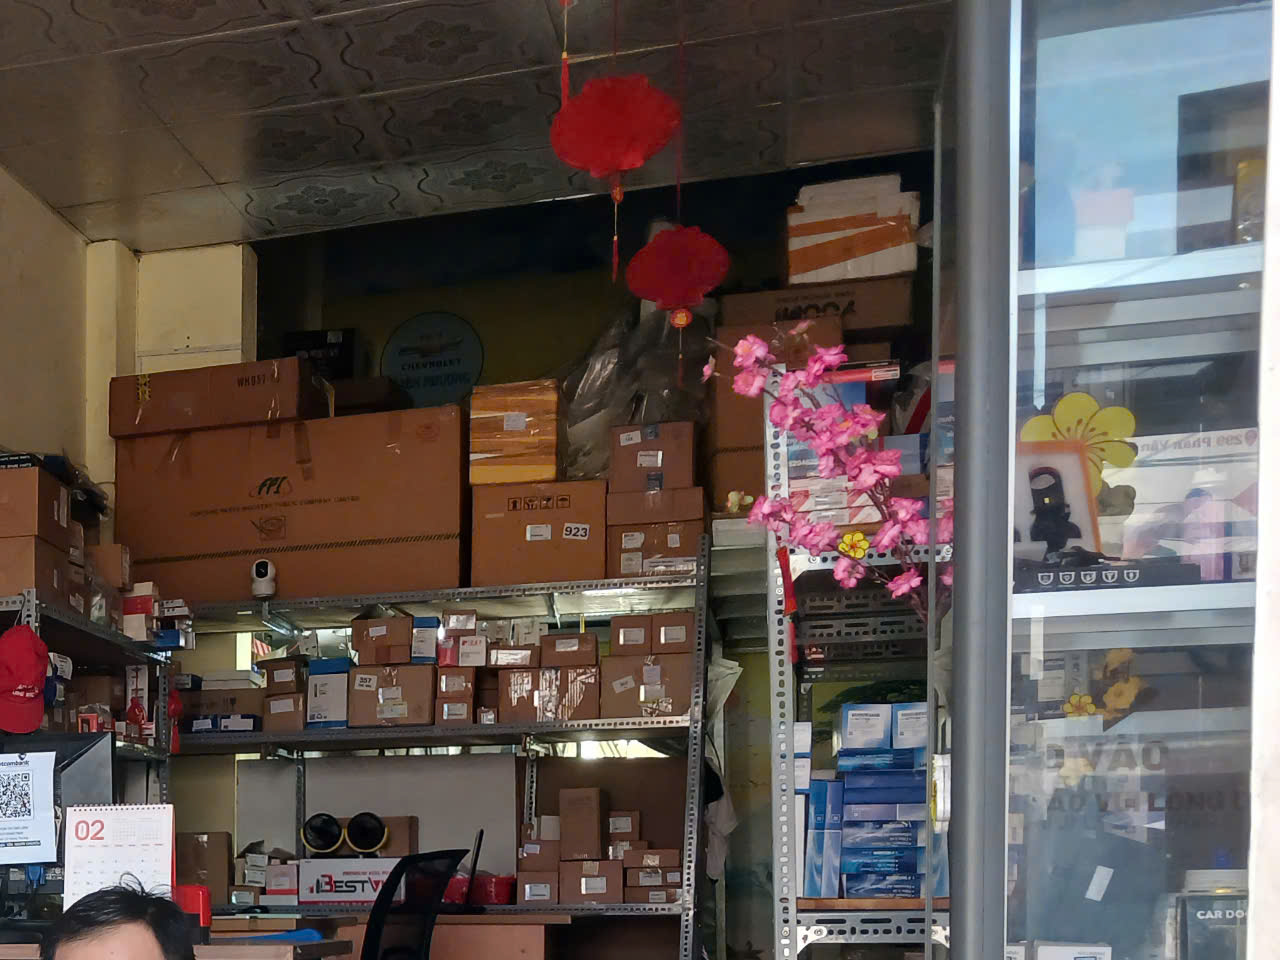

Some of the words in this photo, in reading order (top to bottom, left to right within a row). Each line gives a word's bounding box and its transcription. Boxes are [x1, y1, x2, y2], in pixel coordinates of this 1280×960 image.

[564, 526, 588, 538] 923
[75, 820, 105, 841] 02
[1196, 910, 1223, 919] CAR
